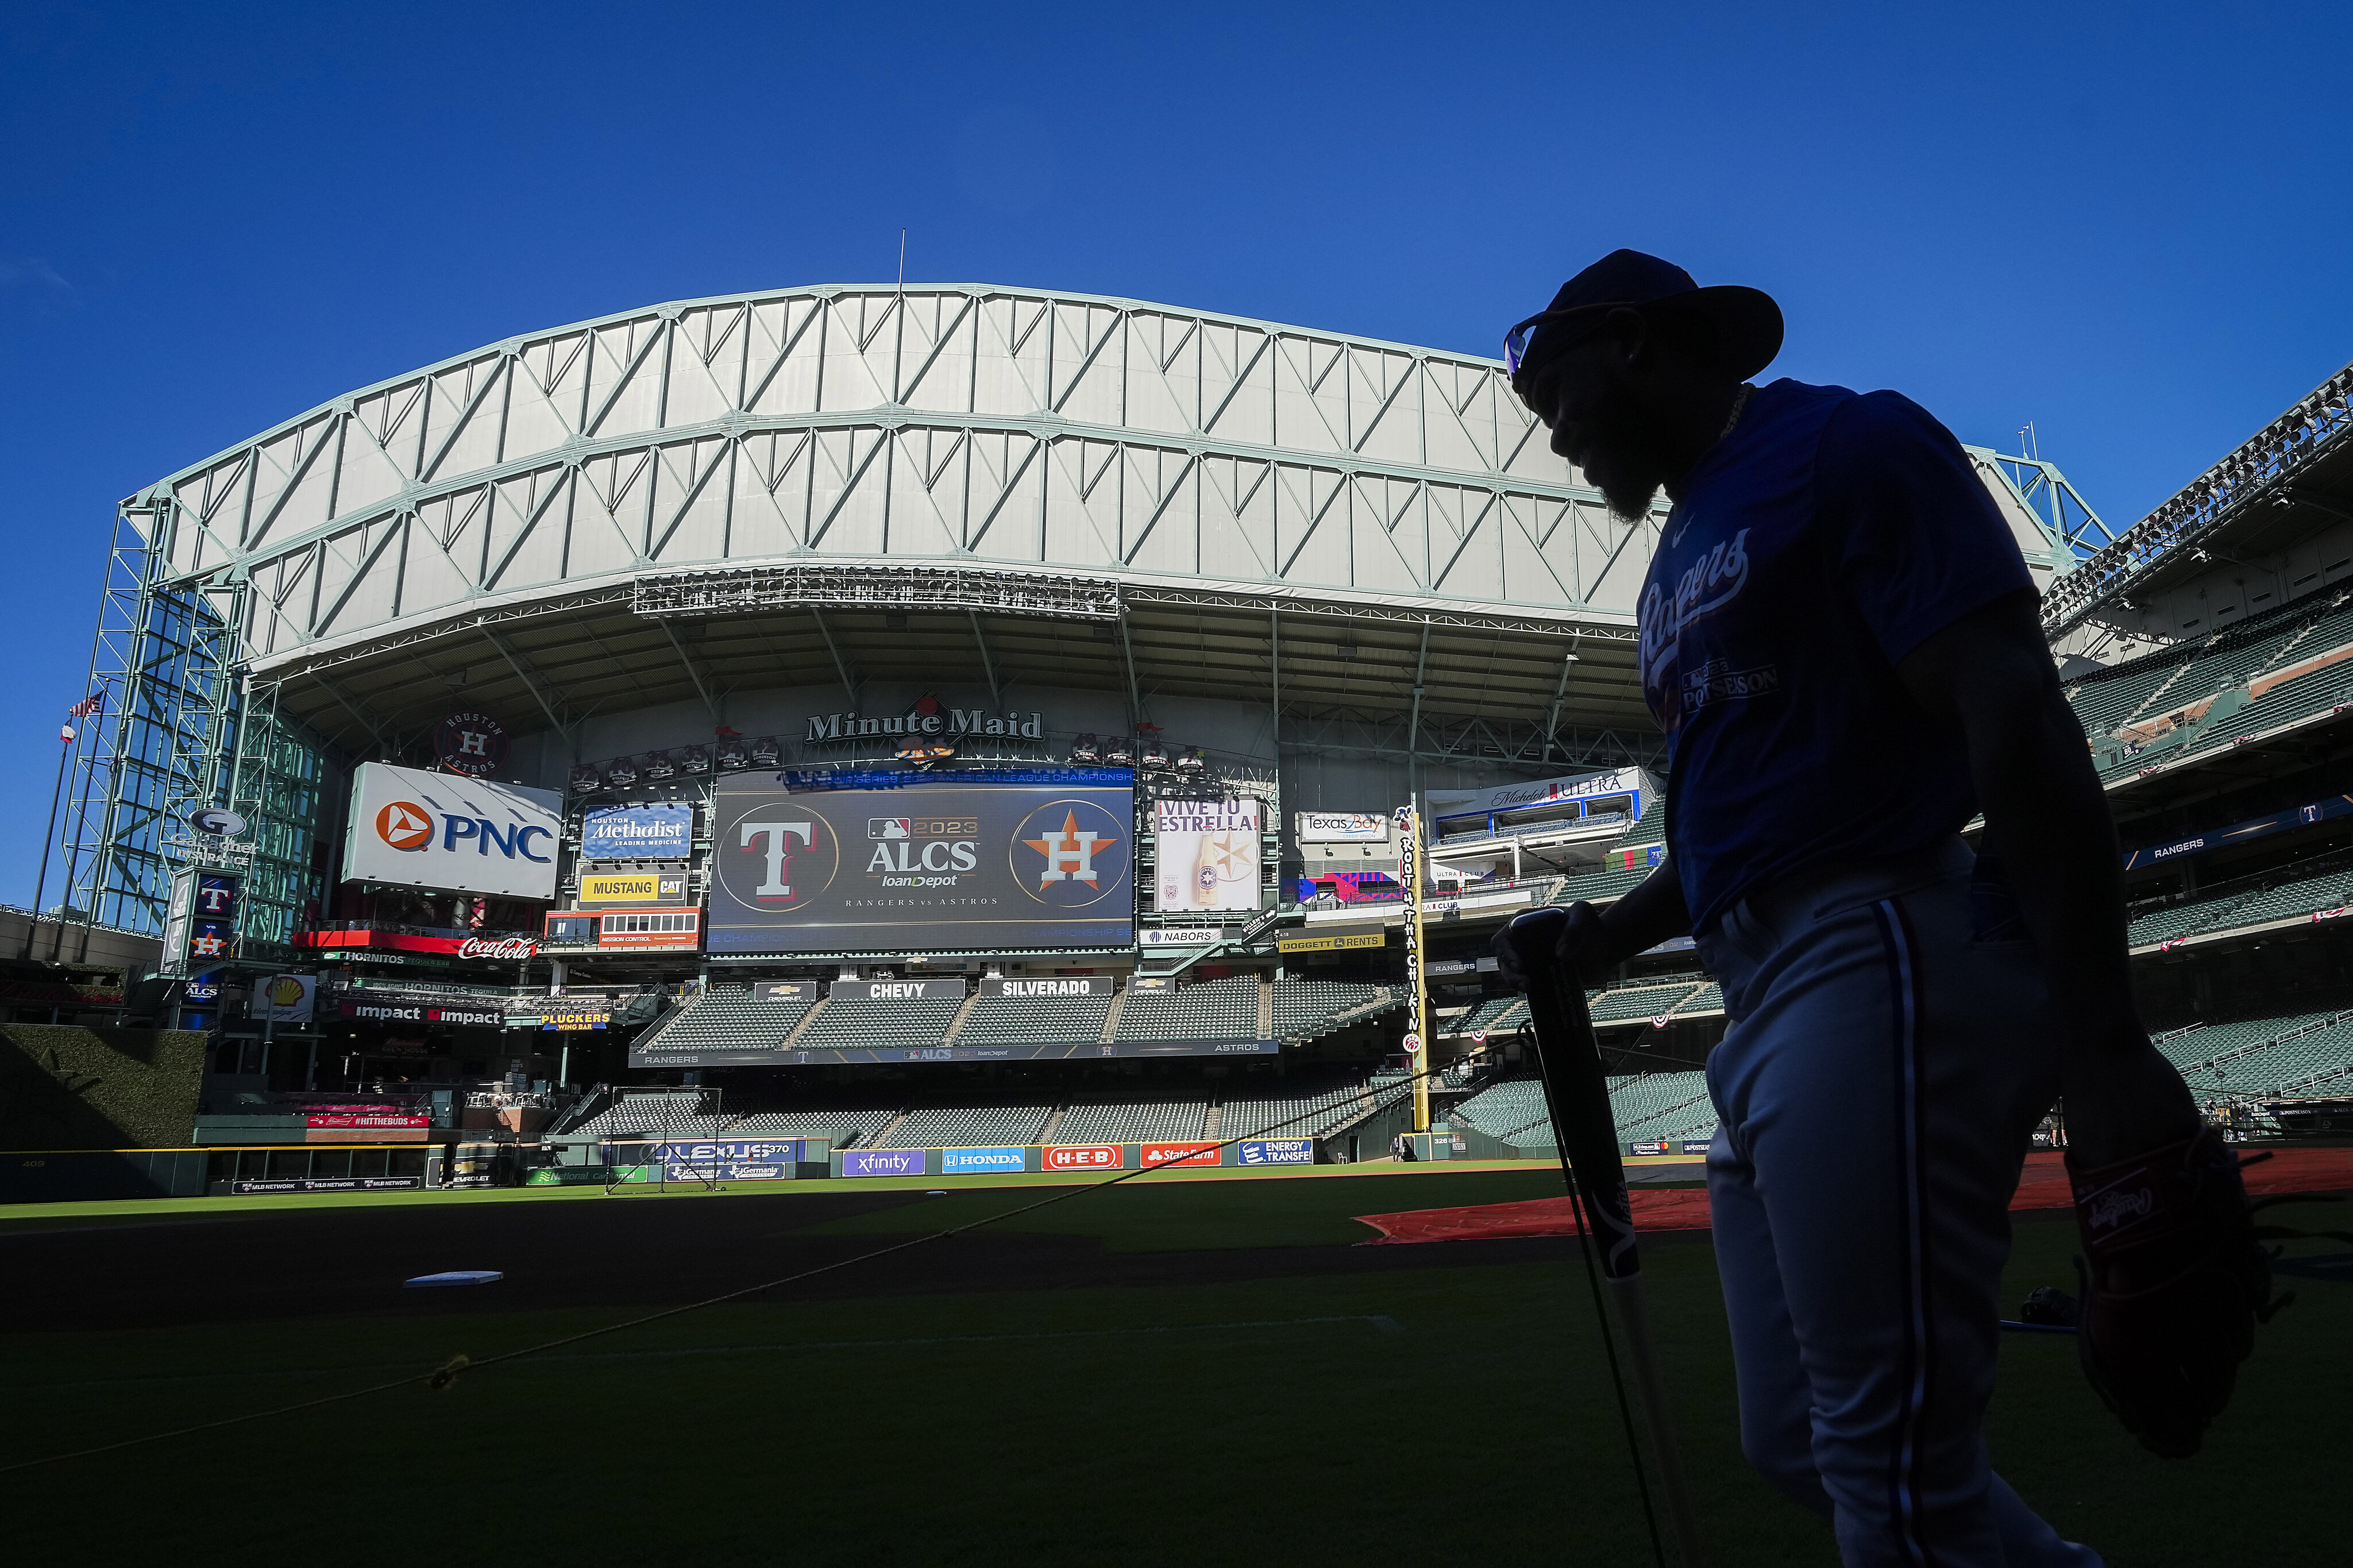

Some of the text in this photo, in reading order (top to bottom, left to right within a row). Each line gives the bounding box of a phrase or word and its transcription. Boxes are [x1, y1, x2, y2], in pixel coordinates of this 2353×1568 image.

[447, 713, 503, 735] HOUSTON
[806, 709, 1043, 741] Minute Maid
[460, 731, 487, 756] H
[445, 755, 495, 773] ASTROS
[856, 775, 898, 783] SERIES
[937, 774, 1001, 782] AMERICAN
[1491, 776, 1623, 806] Michelob ULTRA
[1217, 800, 1240, 815] TU
[591, 821, 682, 839] Methodist
[914, 822, 978, 833] 2023
[1159, 816, 1257, 832] ESTRELLA!
[1306, 814, 1382, 833] Texas Bay
[171, 833, 259, 855] Gallagher
[441, 813, 552, 863] PNC
[866, 841, 977, 872] ALCS
[2155, 839, 2204, 859] RANGERS
[177, 849, 250, 866] INSURANCE
[1402, 838, 1415, 887] ROOT
[594, 880, 683, 894] MUSTANG CAT
[882, 875, 958, 889] loanDepot
[1164, 931, 1211, 941] NABORS
[1403, 910, 1416, 949] THA
[458, 937, 537, 960] Coca-Cola
[1283, 937, 1378, 949] DOGGETT RENTS
[346, 952, 405, 964] HORNITOS
[1436, 964, 1475, 972] RANGERS
[186, 988, 218, 996] ALCS
[870, 983, 925, 998] CHEVY
[1002, 980, 1090, 995] SILVERADO
[356, 1005, 421, 1020] impact
[441, 1009, 500, 1025] impact
[541, 1014, 611, 1024] PLUCKERS
[921, 1049, 952, 1060] ALCS
[1214, 1044, 1259, 1052] ASTROS
[645, 1056, 699, 1064] RANGERS
[675, 1145, 770, 1159] LEXUS
[769, 1145, 789, 1153] 370
[1266, 1141, 1304, 1150] ENERGY
[959, 1155, 1023, 1165] HONDA
[1057, 1152, 1108, 1163] H-E-B
[1164, 1149, 1189, 1160] State
[858, 1154, 911, 1173] xfinity
[550, 1171, 589, 1181] National
